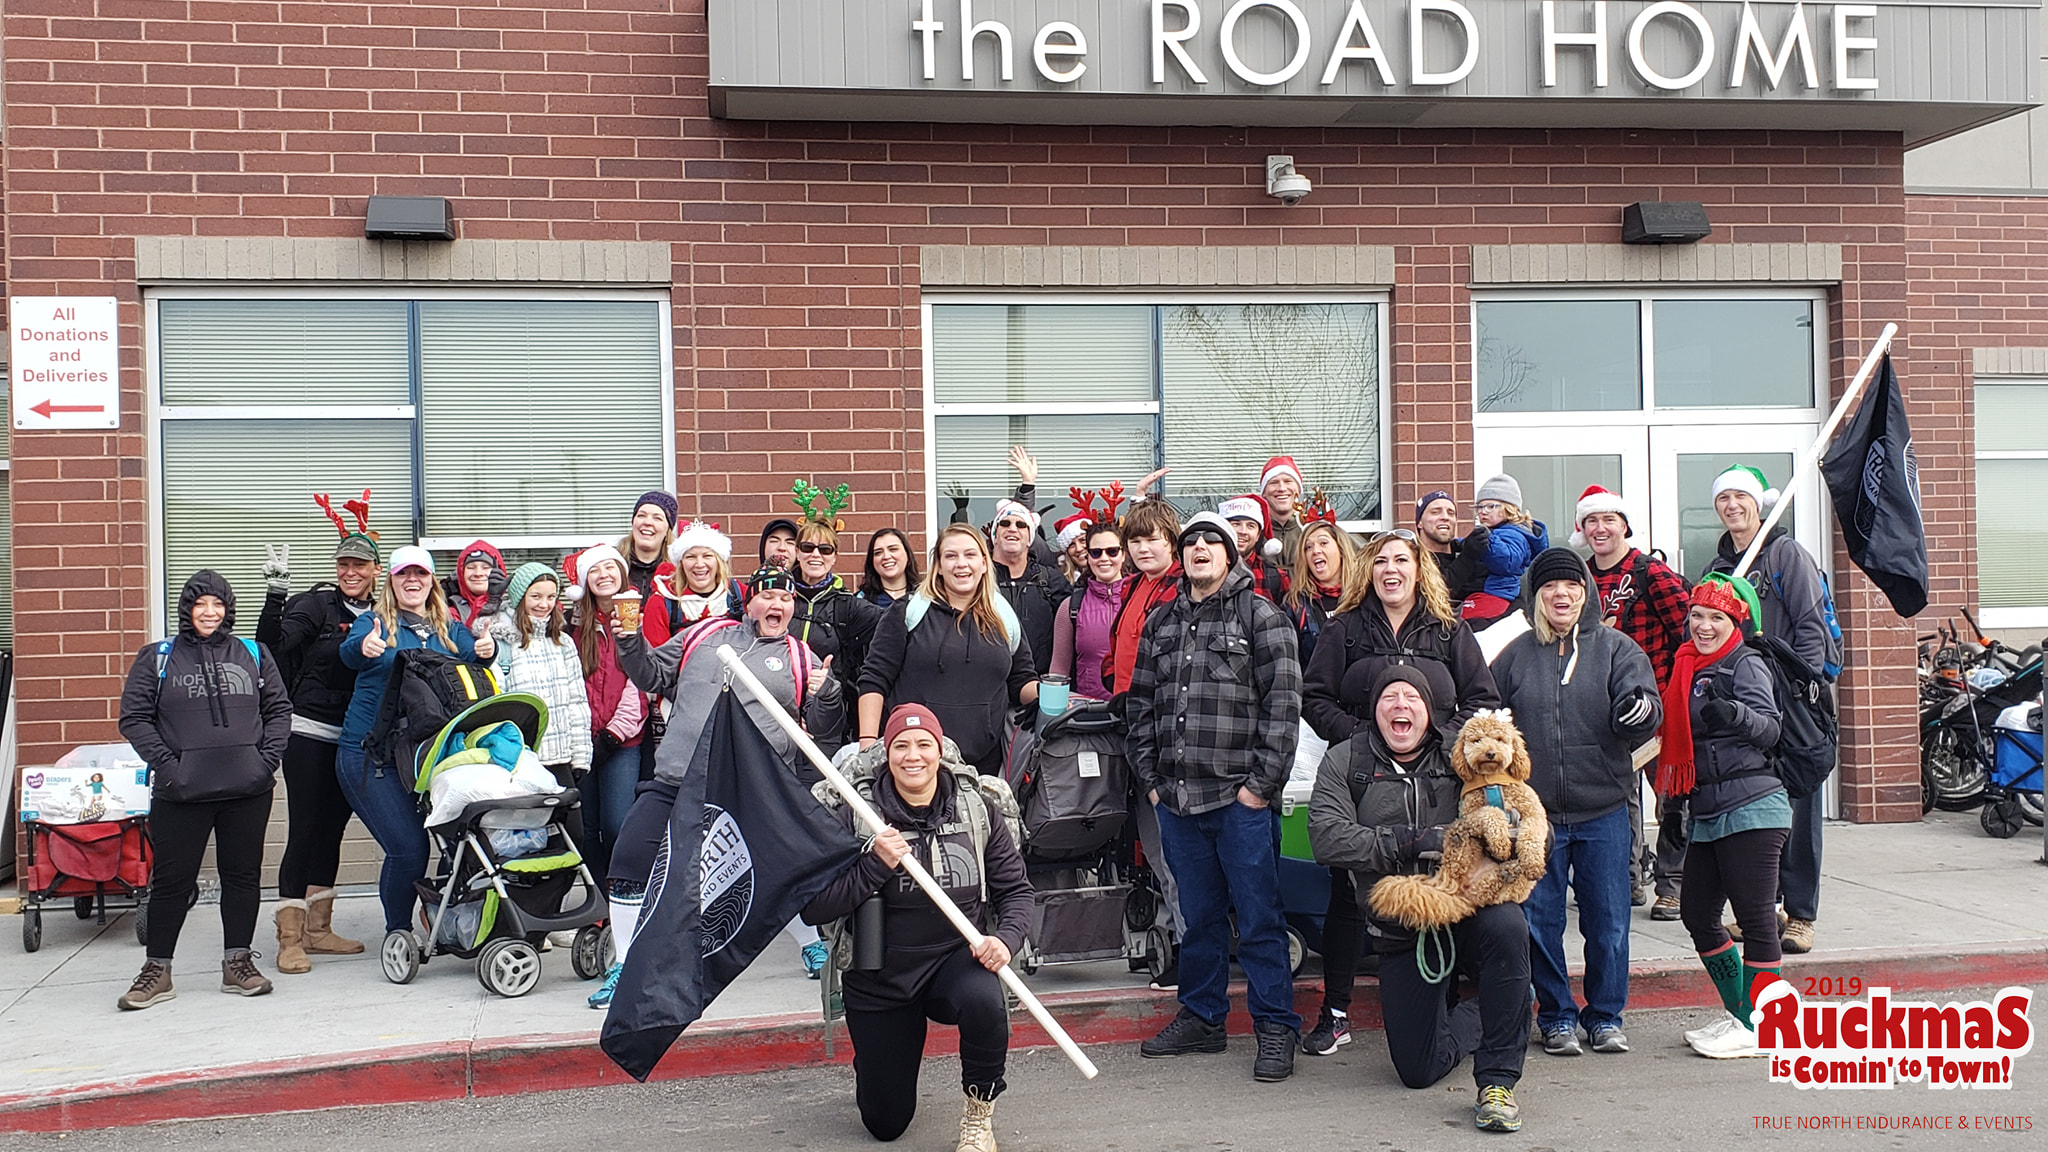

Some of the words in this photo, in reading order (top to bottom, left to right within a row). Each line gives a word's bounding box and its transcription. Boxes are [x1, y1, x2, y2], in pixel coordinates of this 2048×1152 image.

[912, 0, 1087, 84] the
[1152, 0, 1479, 87] ROAD
[1542, 0, 1879, 90] HOME
[53, 307, 75, 321] All
[20, 327, 109, 341] Donations
[49, 348, 81, 361] and
[23, 368, 108, 382] Deliveries
[195, 661, 223, 674] THE
[716, 853, 747, 884] EVENTS
